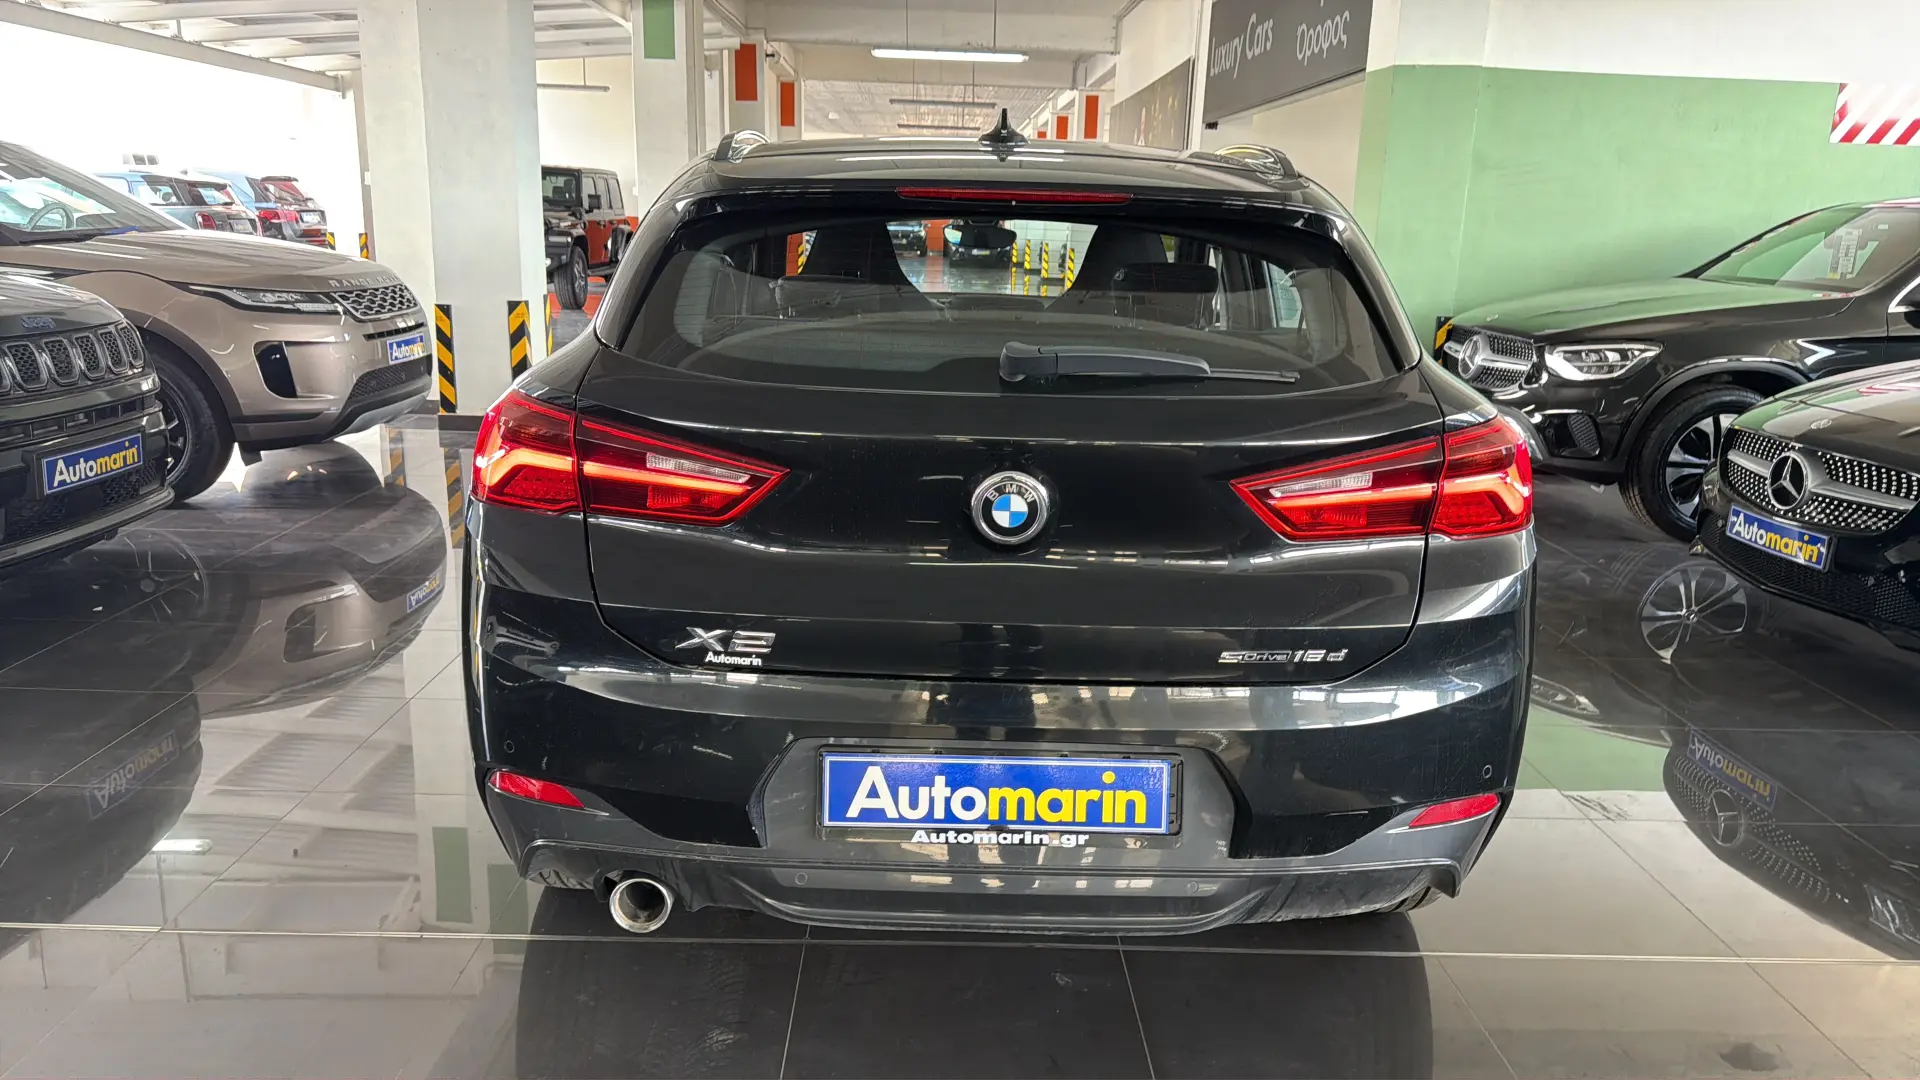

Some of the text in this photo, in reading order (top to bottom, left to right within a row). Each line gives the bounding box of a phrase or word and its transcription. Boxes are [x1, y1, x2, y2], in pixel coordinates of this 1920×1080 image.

[1210, 13, 1273, 79] Luxury Cars
[53, 441, 138, 487] Automarin
[986, 483, 1036, 503] BMW
[1732, 512, 1819, 563] Automarin
[675, 626, 776, 653] X2
[705, 651, 761, 666] Automarin
[846, 766, 1146, 824] Automarin
[911, 830, 1089, 848] Automarin.gr
